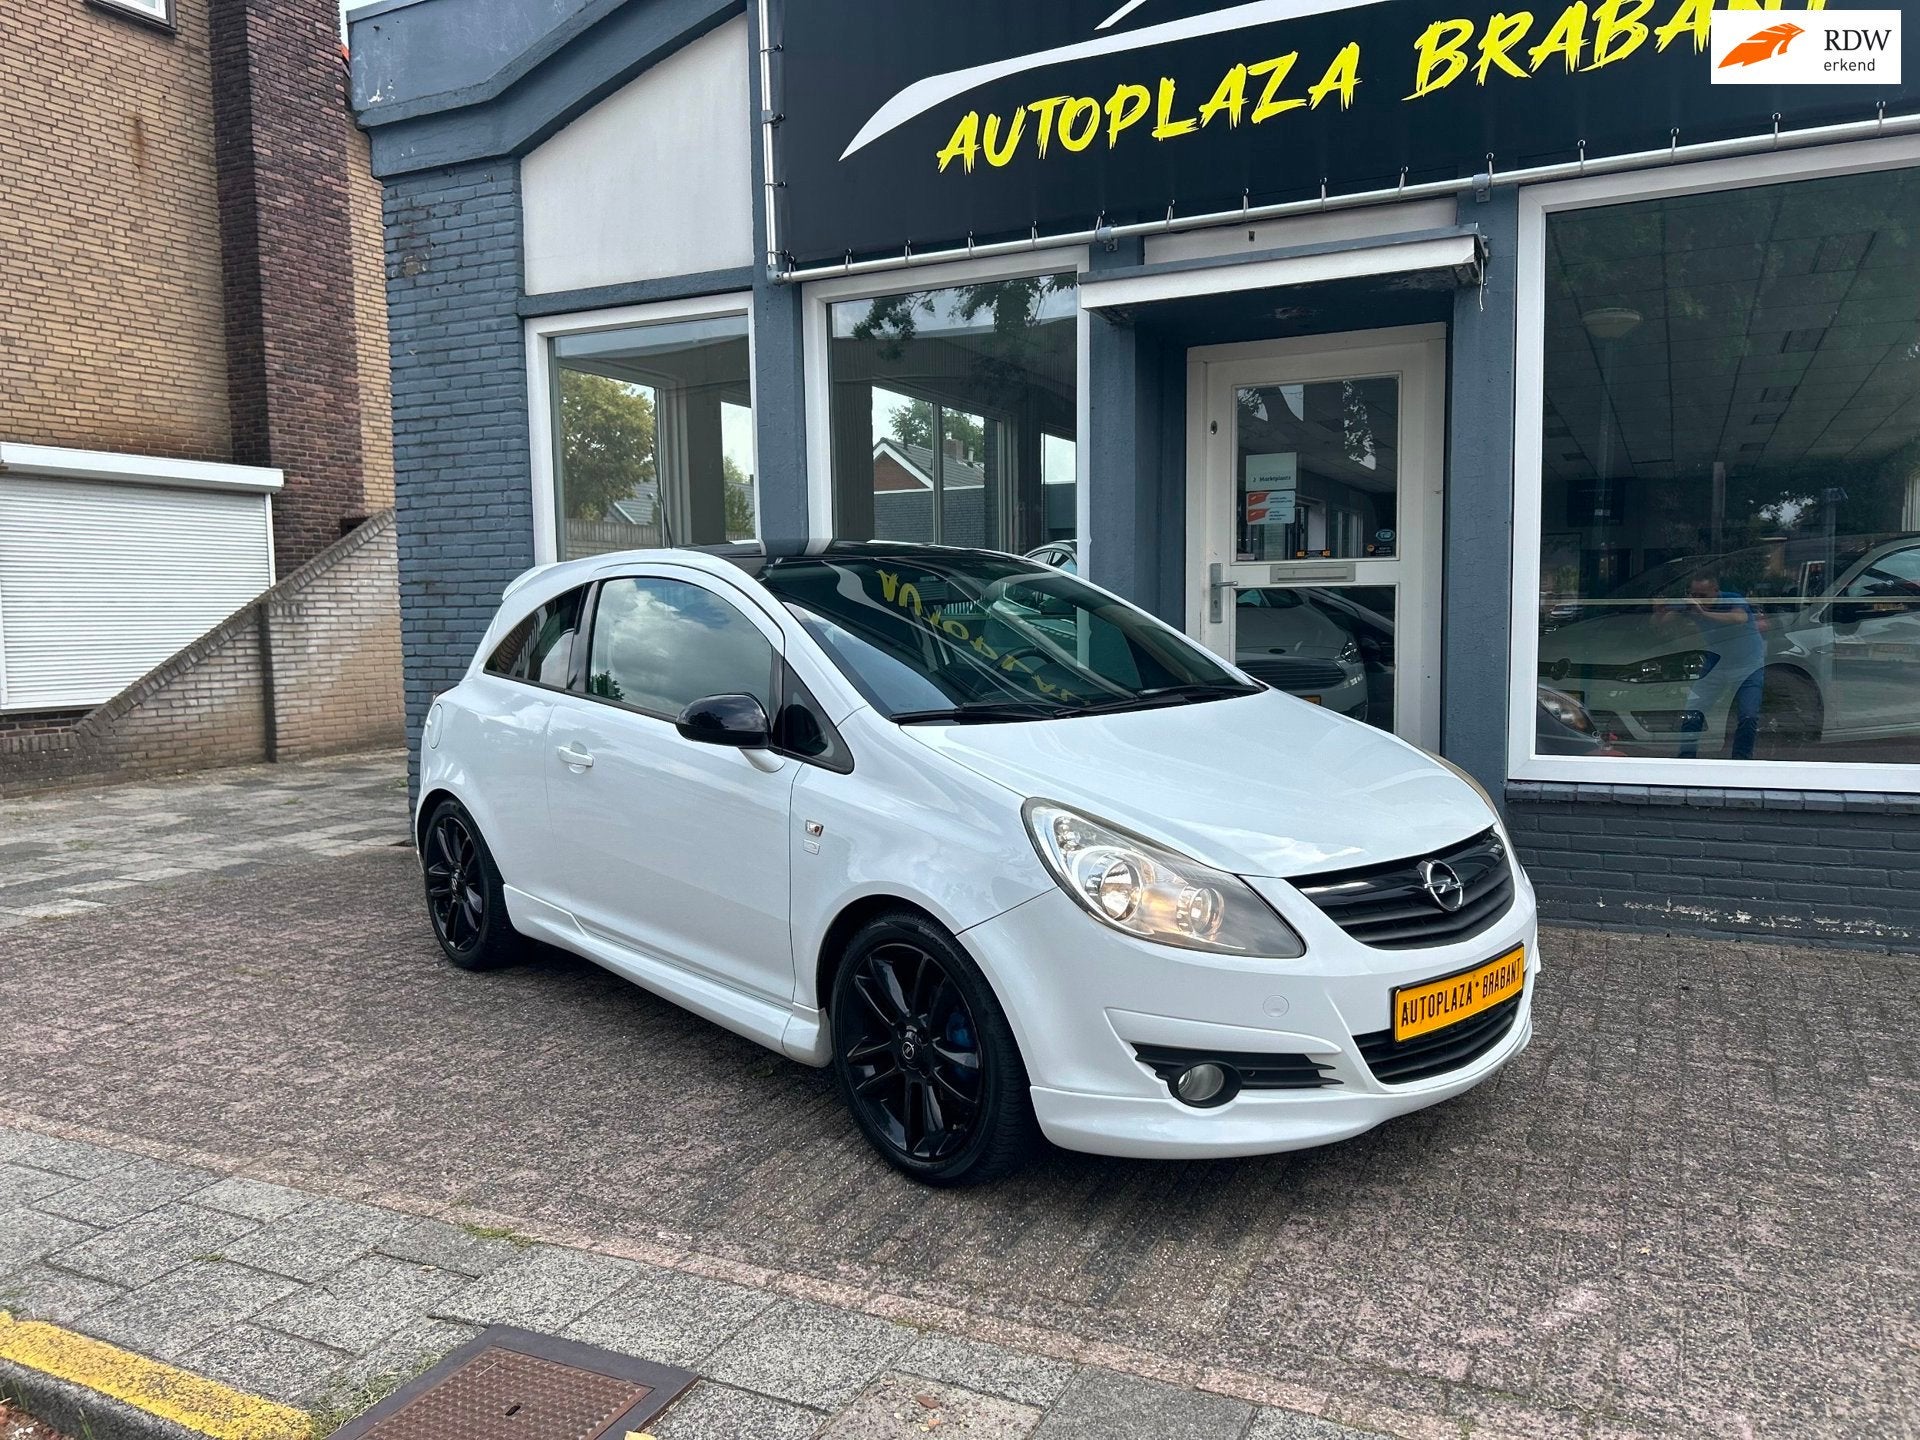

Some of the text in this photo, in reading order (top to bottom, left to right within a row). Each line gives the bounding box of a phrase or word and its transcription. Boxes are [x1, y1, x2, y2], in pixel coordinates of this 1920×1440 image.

[936, 0, 1826, 174] AUTOPLAZA BRABA
[1401, 958, 1521, 1027] AUTOPLAZA BRABANT
